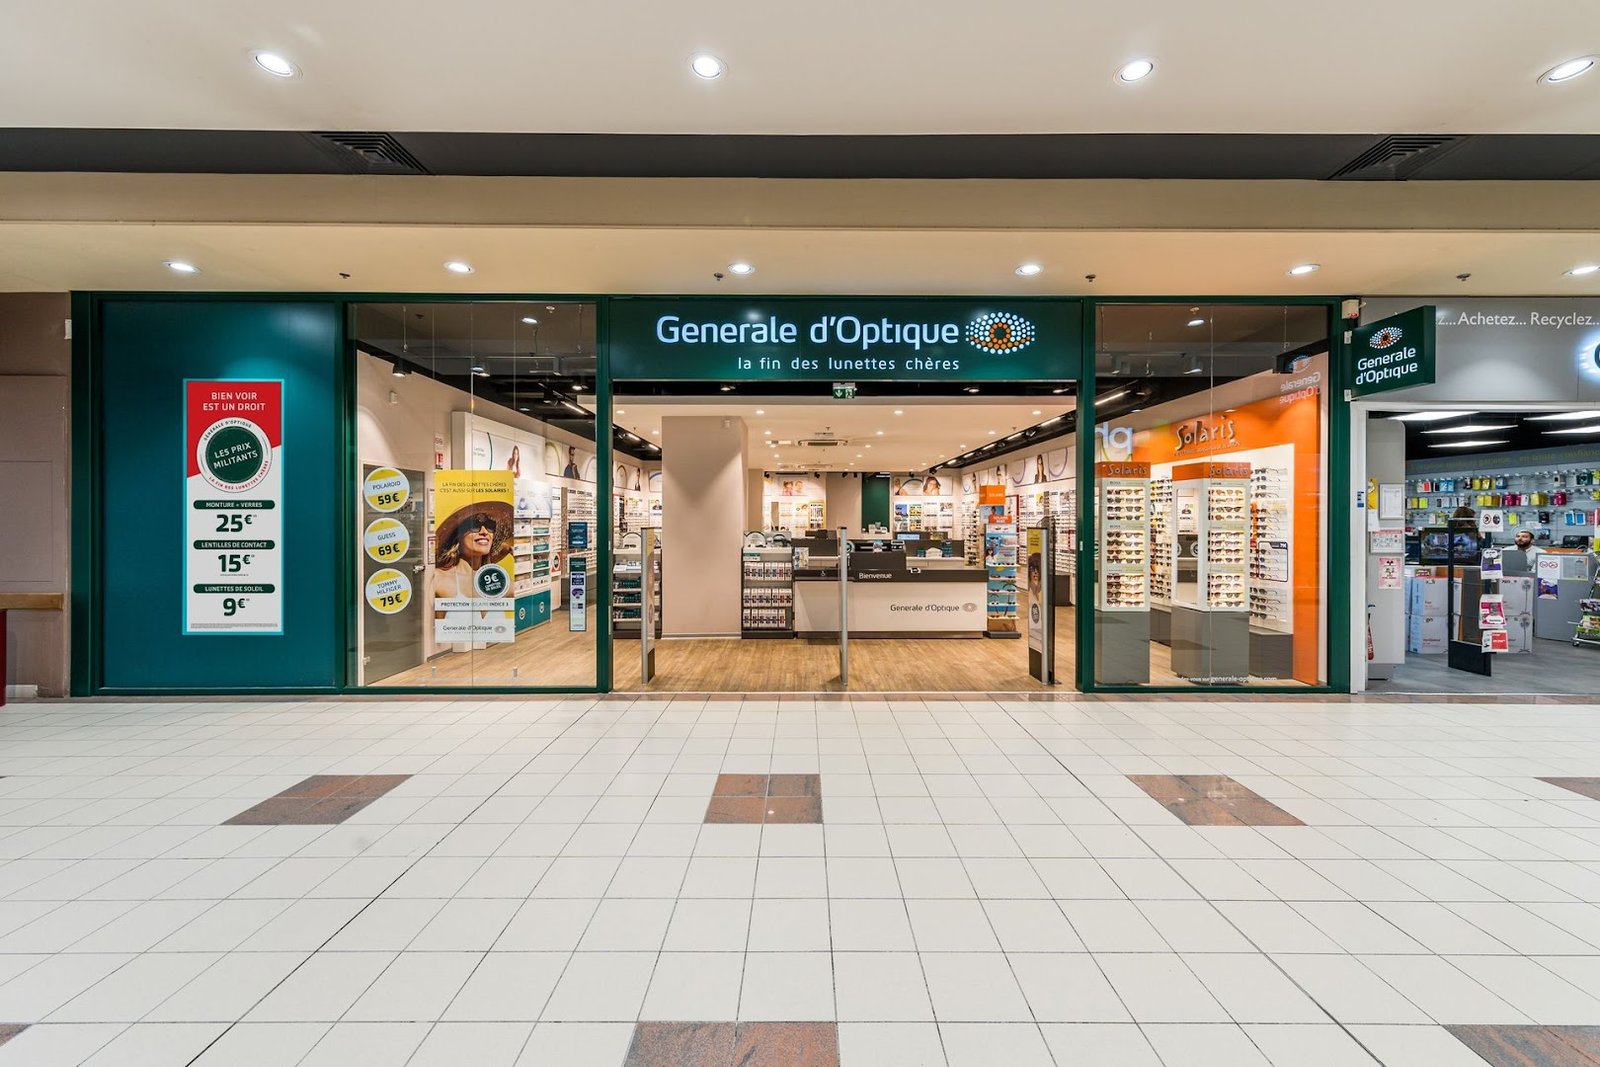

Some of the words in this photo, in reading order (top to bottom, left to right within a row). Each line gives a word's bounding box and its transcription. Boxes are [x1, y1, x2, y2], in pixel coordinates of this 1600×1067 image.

[1458, 312, 1526, 326] Achetez...
[656, 316, 797, 344] Generale
[810, 316, 960, 350] d'Optique
[738, 357, 752, 370] la
[760, 357, 781, 370] fin
[791, 357, 818, 370] des
[828, 357, 896, 370] lunettes
[906, 357, 960, 370] chères
[1358, 347, 1416, 372] Generale
[1355, 362, 1418, 386] d'Optique
[211, 392, 233, 400] BIEN
[235, 392, 257, 400] VOIR
[202, 402, 220, 411] EST
[222, 402, 235, 411] UN
[237, 402, 266, 411] DROIT
[1174, 415, 1236, 451] Solaris
[214, 448, 230, 459] LES
[231, 442, 252, 453] PRIX
[213, 450, 258, 469] MILITANTS
[1107, 463, 1148, 476] Solaris
[372, 481, 400, 490] POLAROID
[378, 492, 400, 505] 59€
[216, 514, 252, 532] 25€
[377, 532, 396, 540] GUESS
[378, 543, 400, 556] 69€
[218, 554, 250, 572] 15€
[377, 579, 398, 589] TOMMY
[484, 573, 499, 584] 9€
[377, 585, 402, 595] HILFIGER
[380, 594, 402, 607] 79€
[223, 598, 246, 617] 9€
[925, 604, 960, 613] d'Optique
